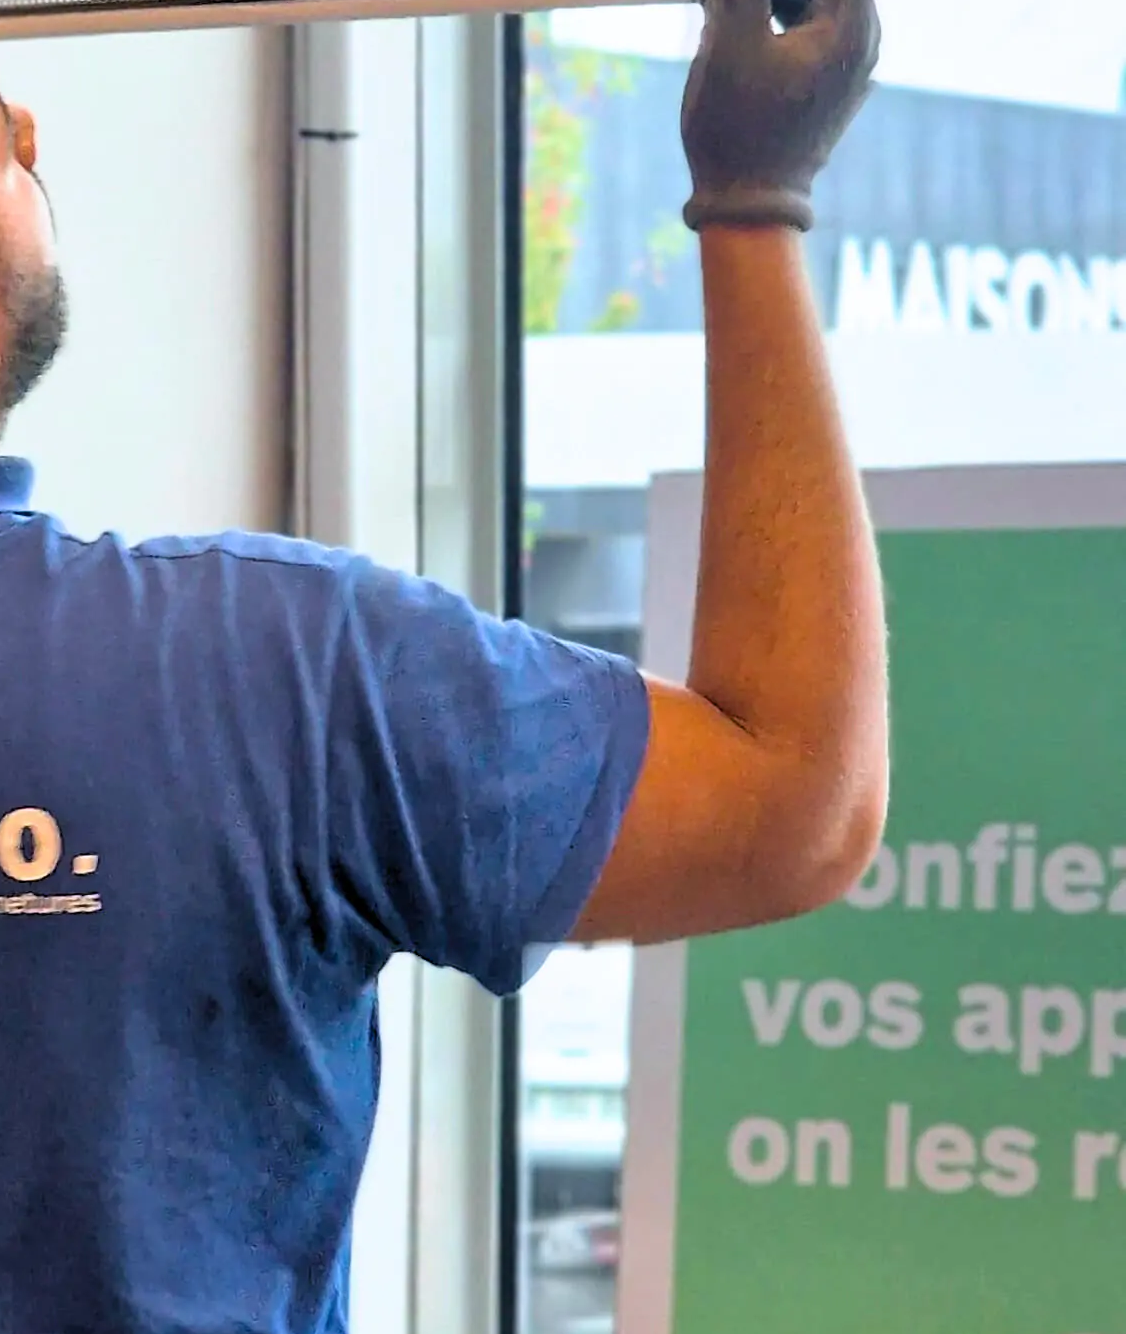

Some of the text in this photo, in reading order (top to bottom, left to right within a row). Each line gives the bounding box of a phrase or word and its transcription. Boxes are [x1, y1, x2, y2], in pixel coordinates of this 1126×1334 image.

[844, 822, 1126, 914] onfie
[742, 979, 923, 1051] vos
[728, 1101, 1126, 1201] on les r
